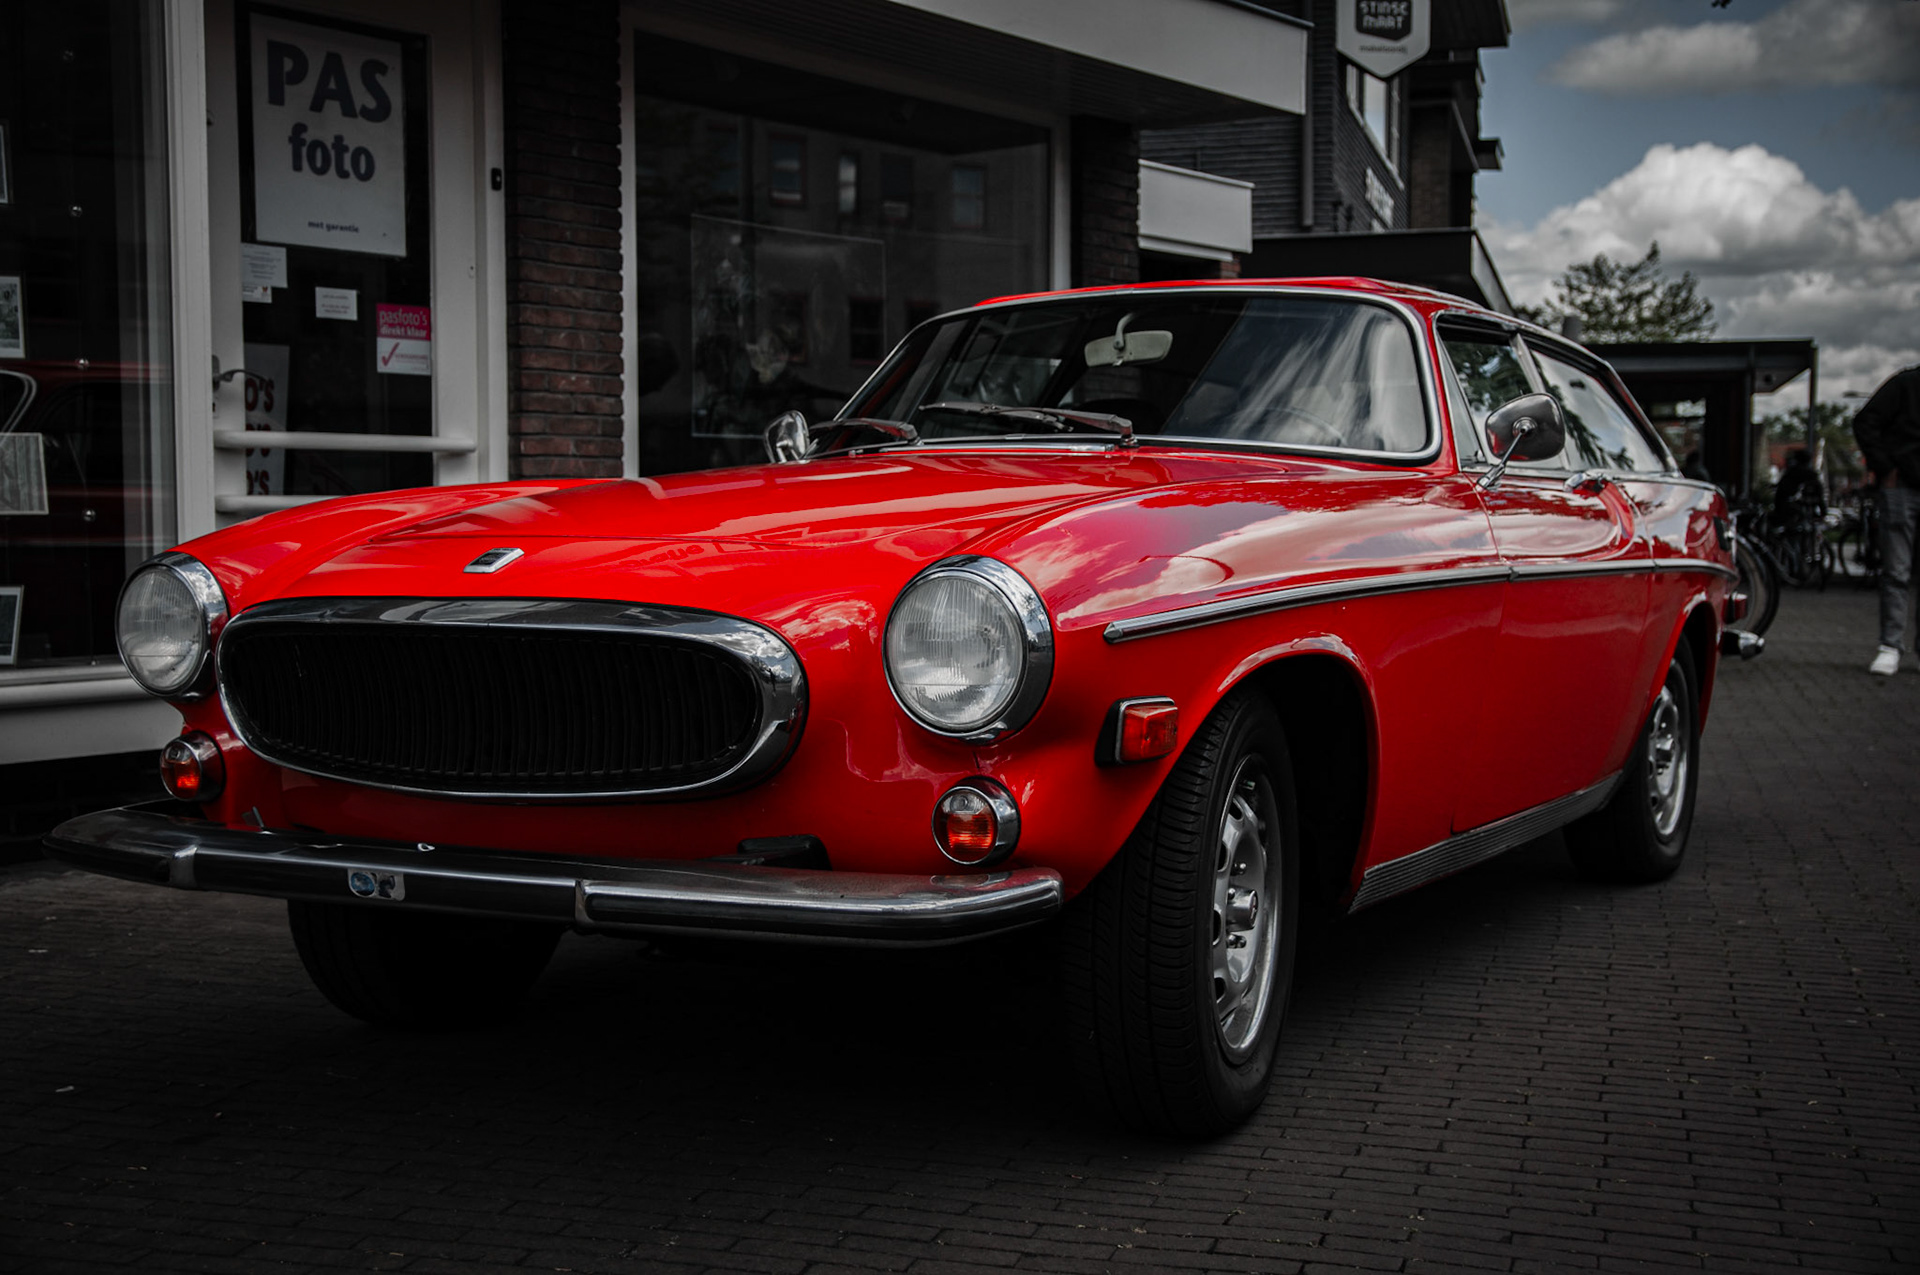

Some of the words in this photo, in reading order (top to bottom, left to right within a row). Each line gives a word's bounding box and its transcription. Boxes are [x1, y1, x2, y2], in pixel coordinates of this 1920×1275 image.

[267, 39, 391, 122] PAS
[288, 122, 375, 181] foto
[308, 221, 324, 229] met
[326, 224, 359, 233] garantie
[379, 307, 428, 326] pasfoto's
[380, 324, 405, 336] direkt
[406, 325, 427, 338] klaar
